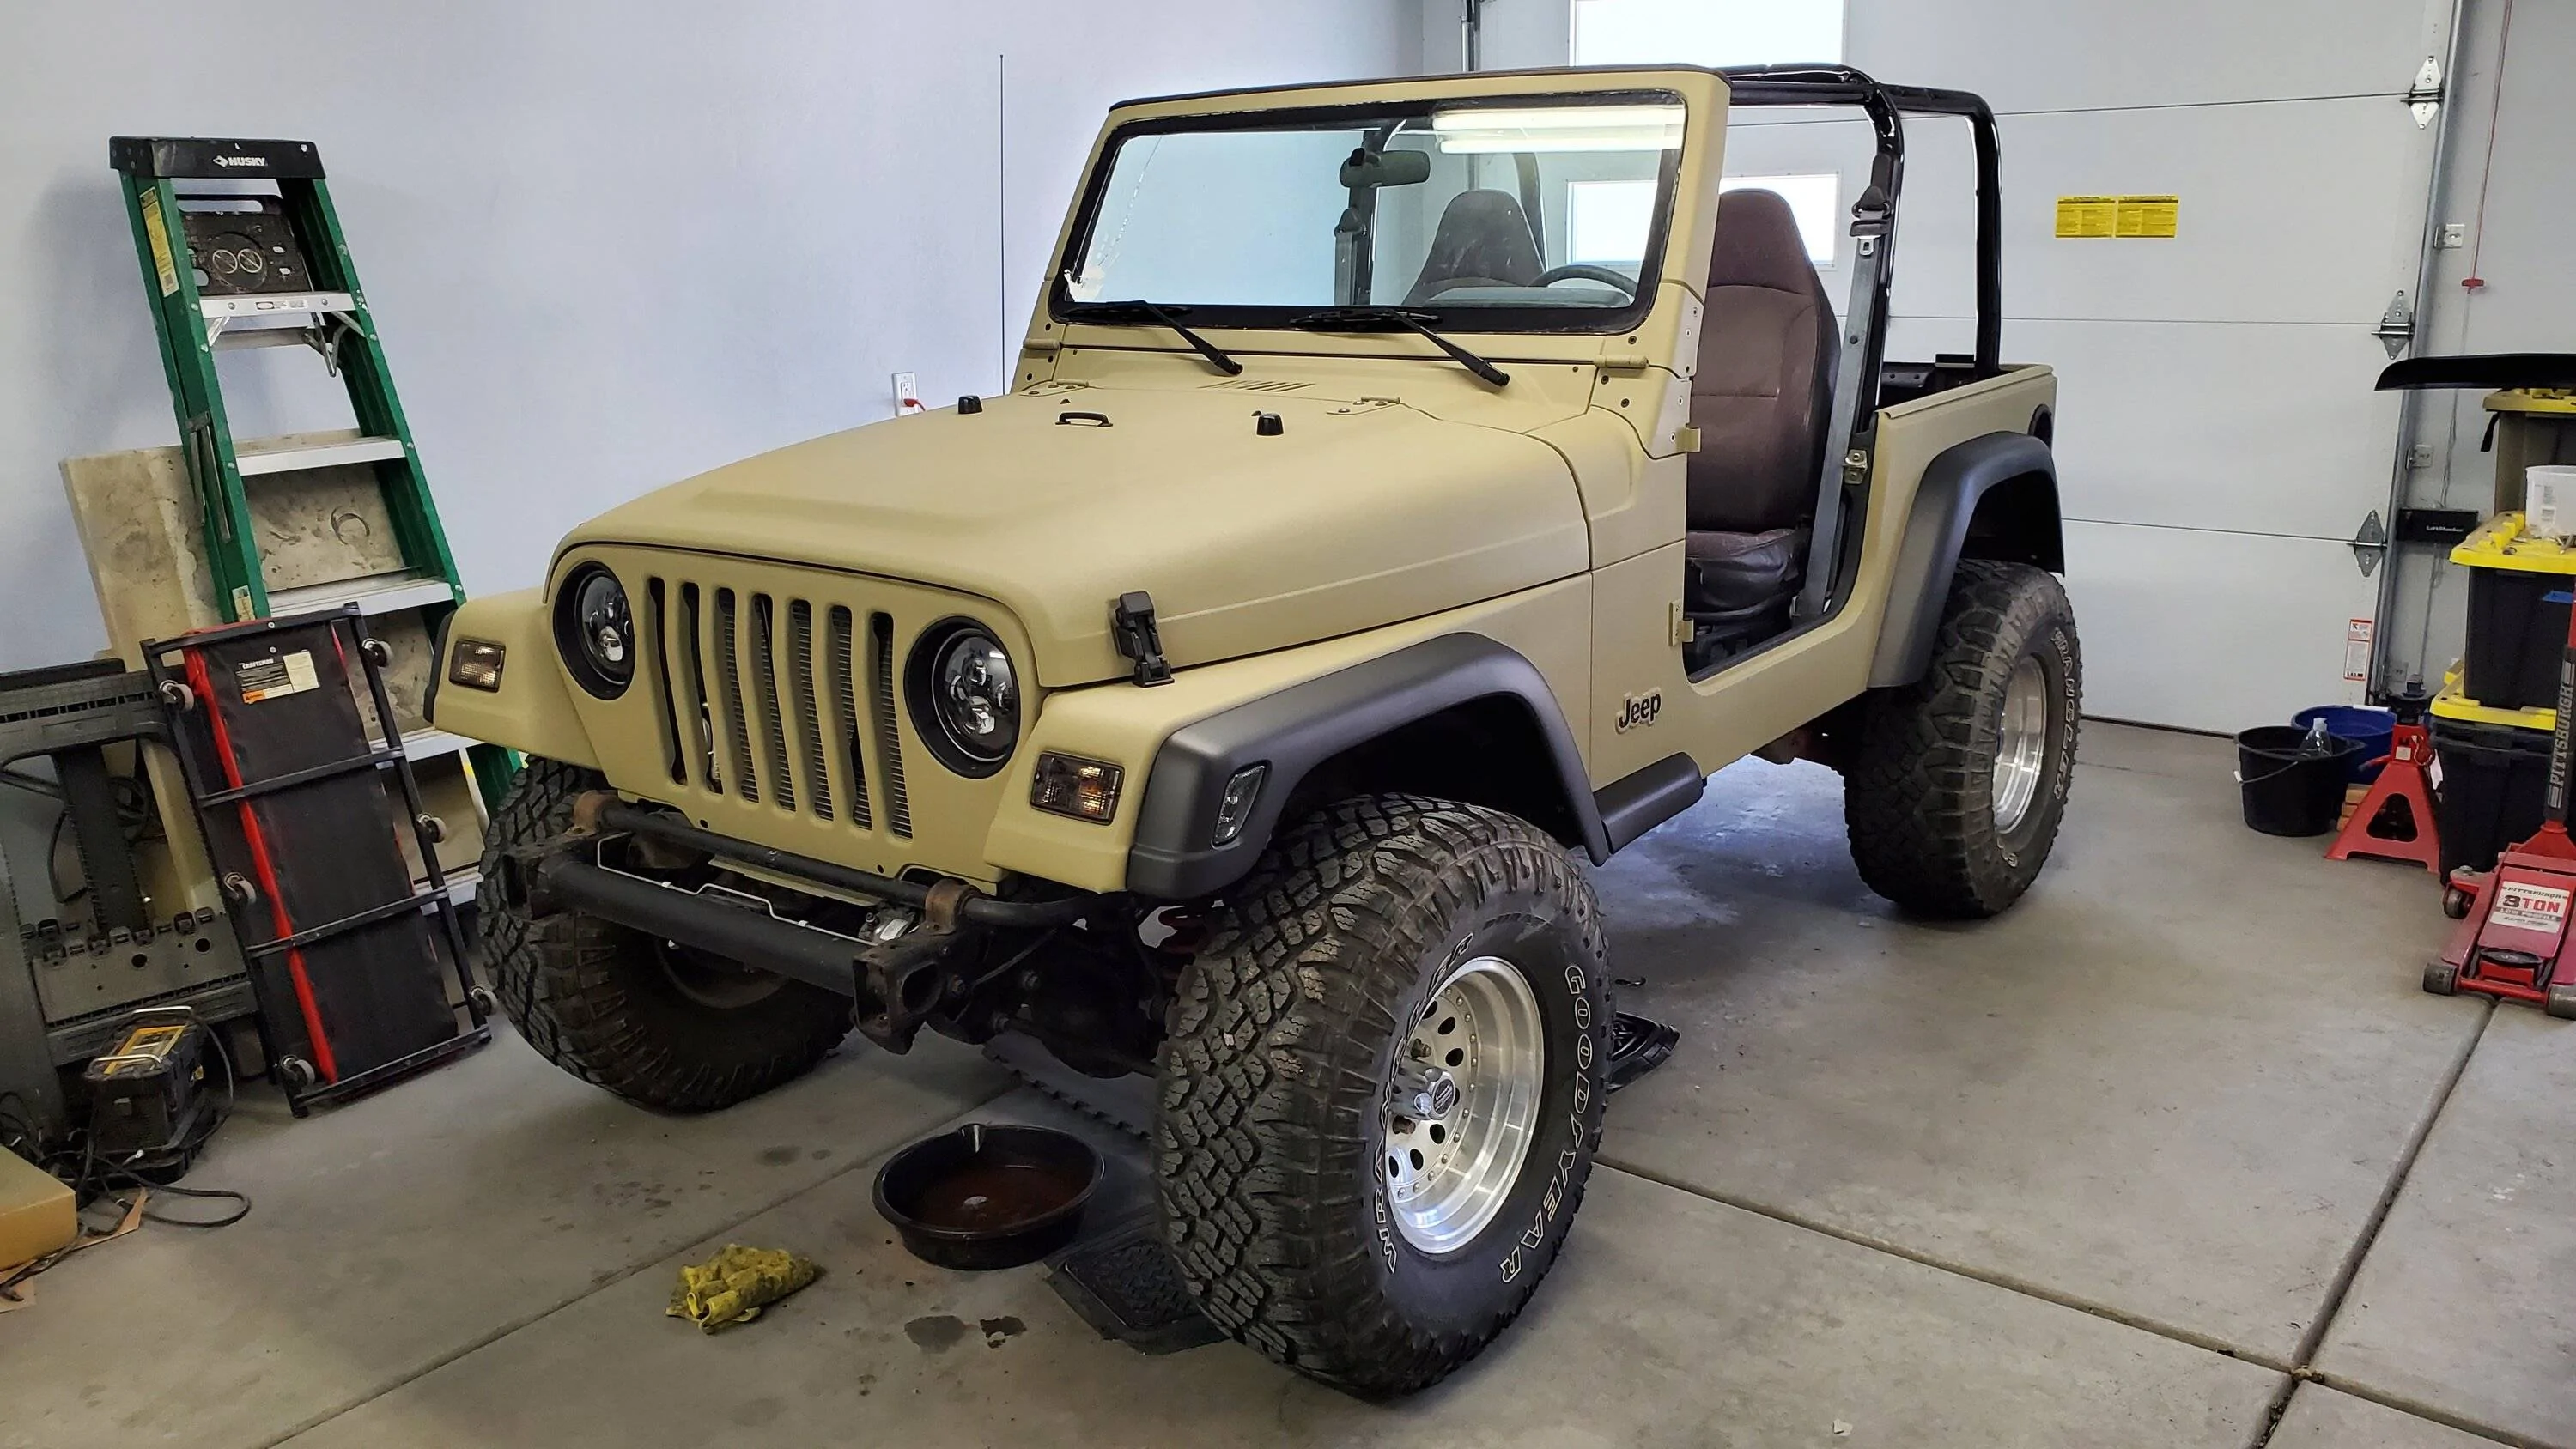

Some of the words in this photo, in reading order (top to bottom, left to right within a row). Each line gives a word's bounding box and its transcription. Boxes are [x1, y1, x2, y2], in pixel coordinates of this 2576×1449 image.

[228, 156, 265, 167] HUSKY
[1617, 692, 1662, 729] Jeep
[2549, 684, 2573, 787] PITTSBURGH
[2507, 887, 2561, 899] PITTSBURGH
[1498, 964, 1593, 1284] GOODYEAR
